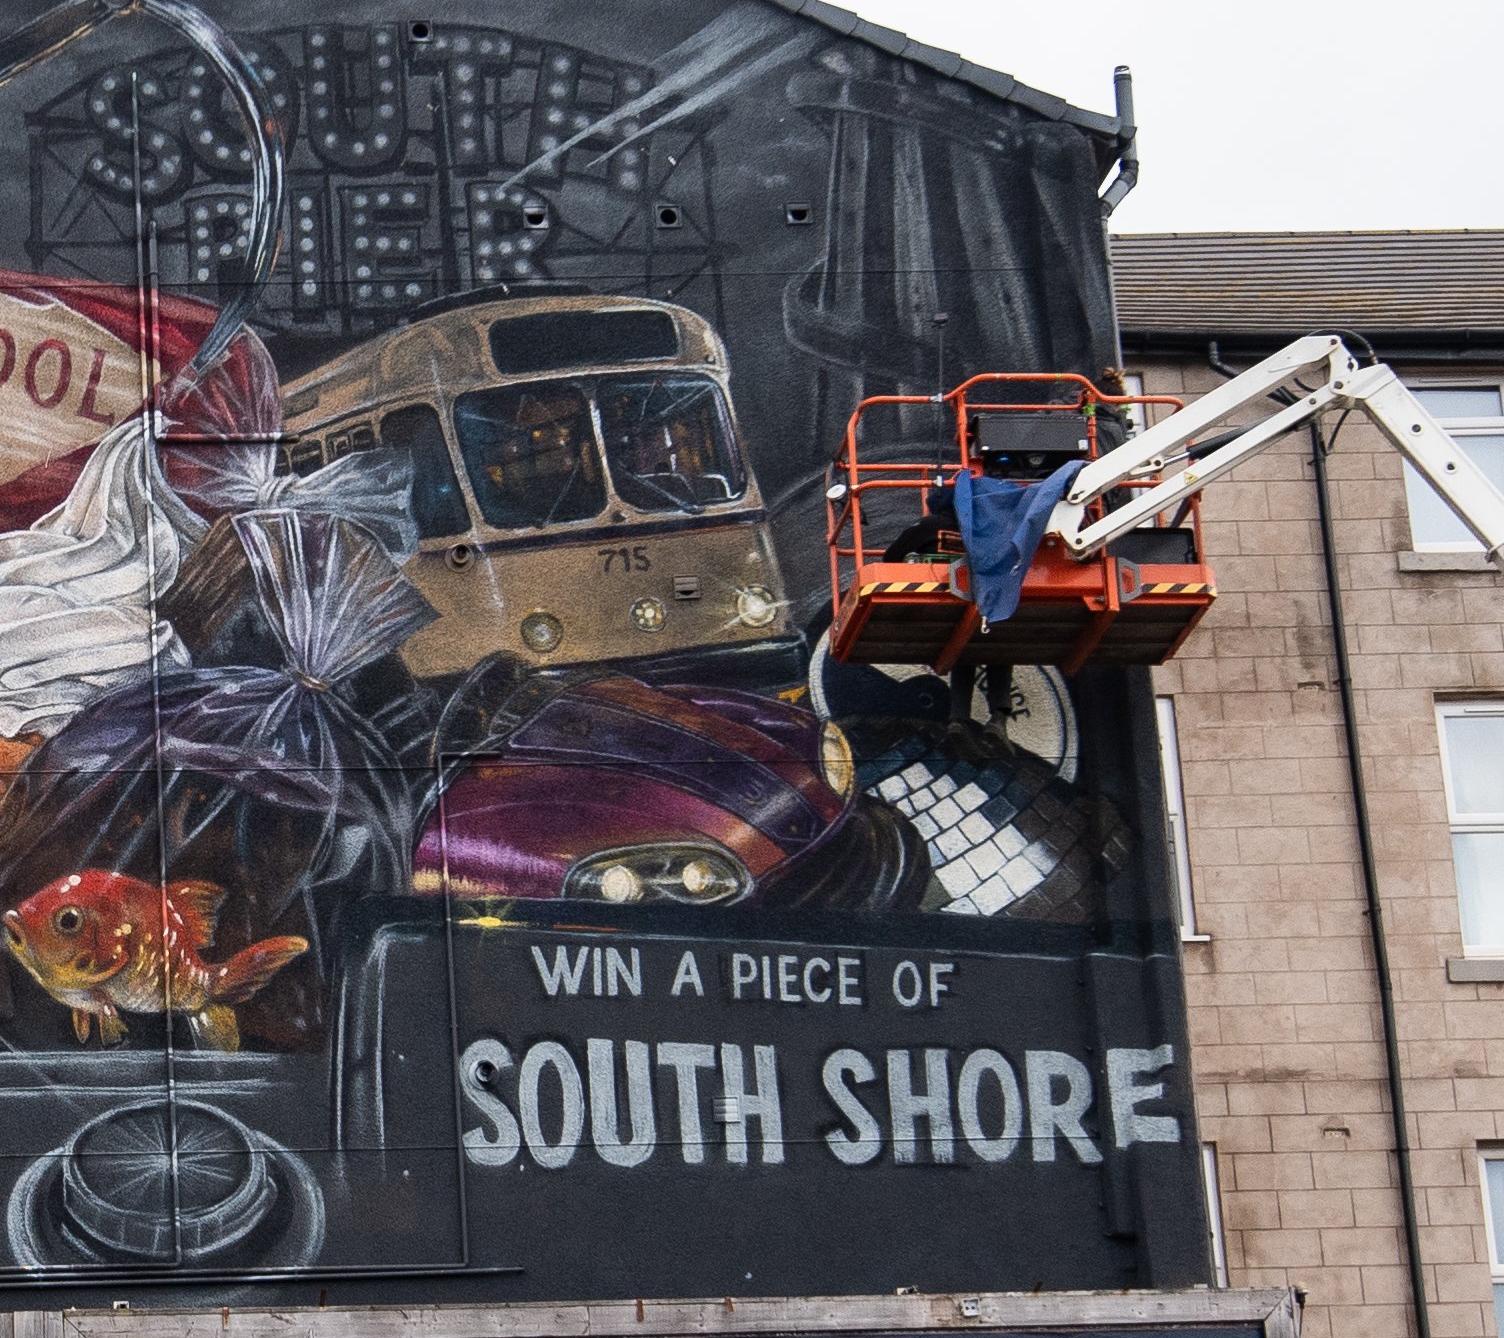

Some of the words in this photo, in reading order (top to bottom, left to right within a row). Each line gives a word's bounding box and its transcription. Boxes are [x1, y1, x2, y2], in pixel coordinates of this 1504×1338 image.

[599, 543, 651, 573] 715
[531, 946, 643, 997] WIN
[670, 953, 704, 997] A
[732, 954, 863, 1006] PIECE
[892, 961, 954, 1008] OF
[458, 1037, 785, 1169] SOUTH
[821, 1043, 1182, 1166] SHORE
